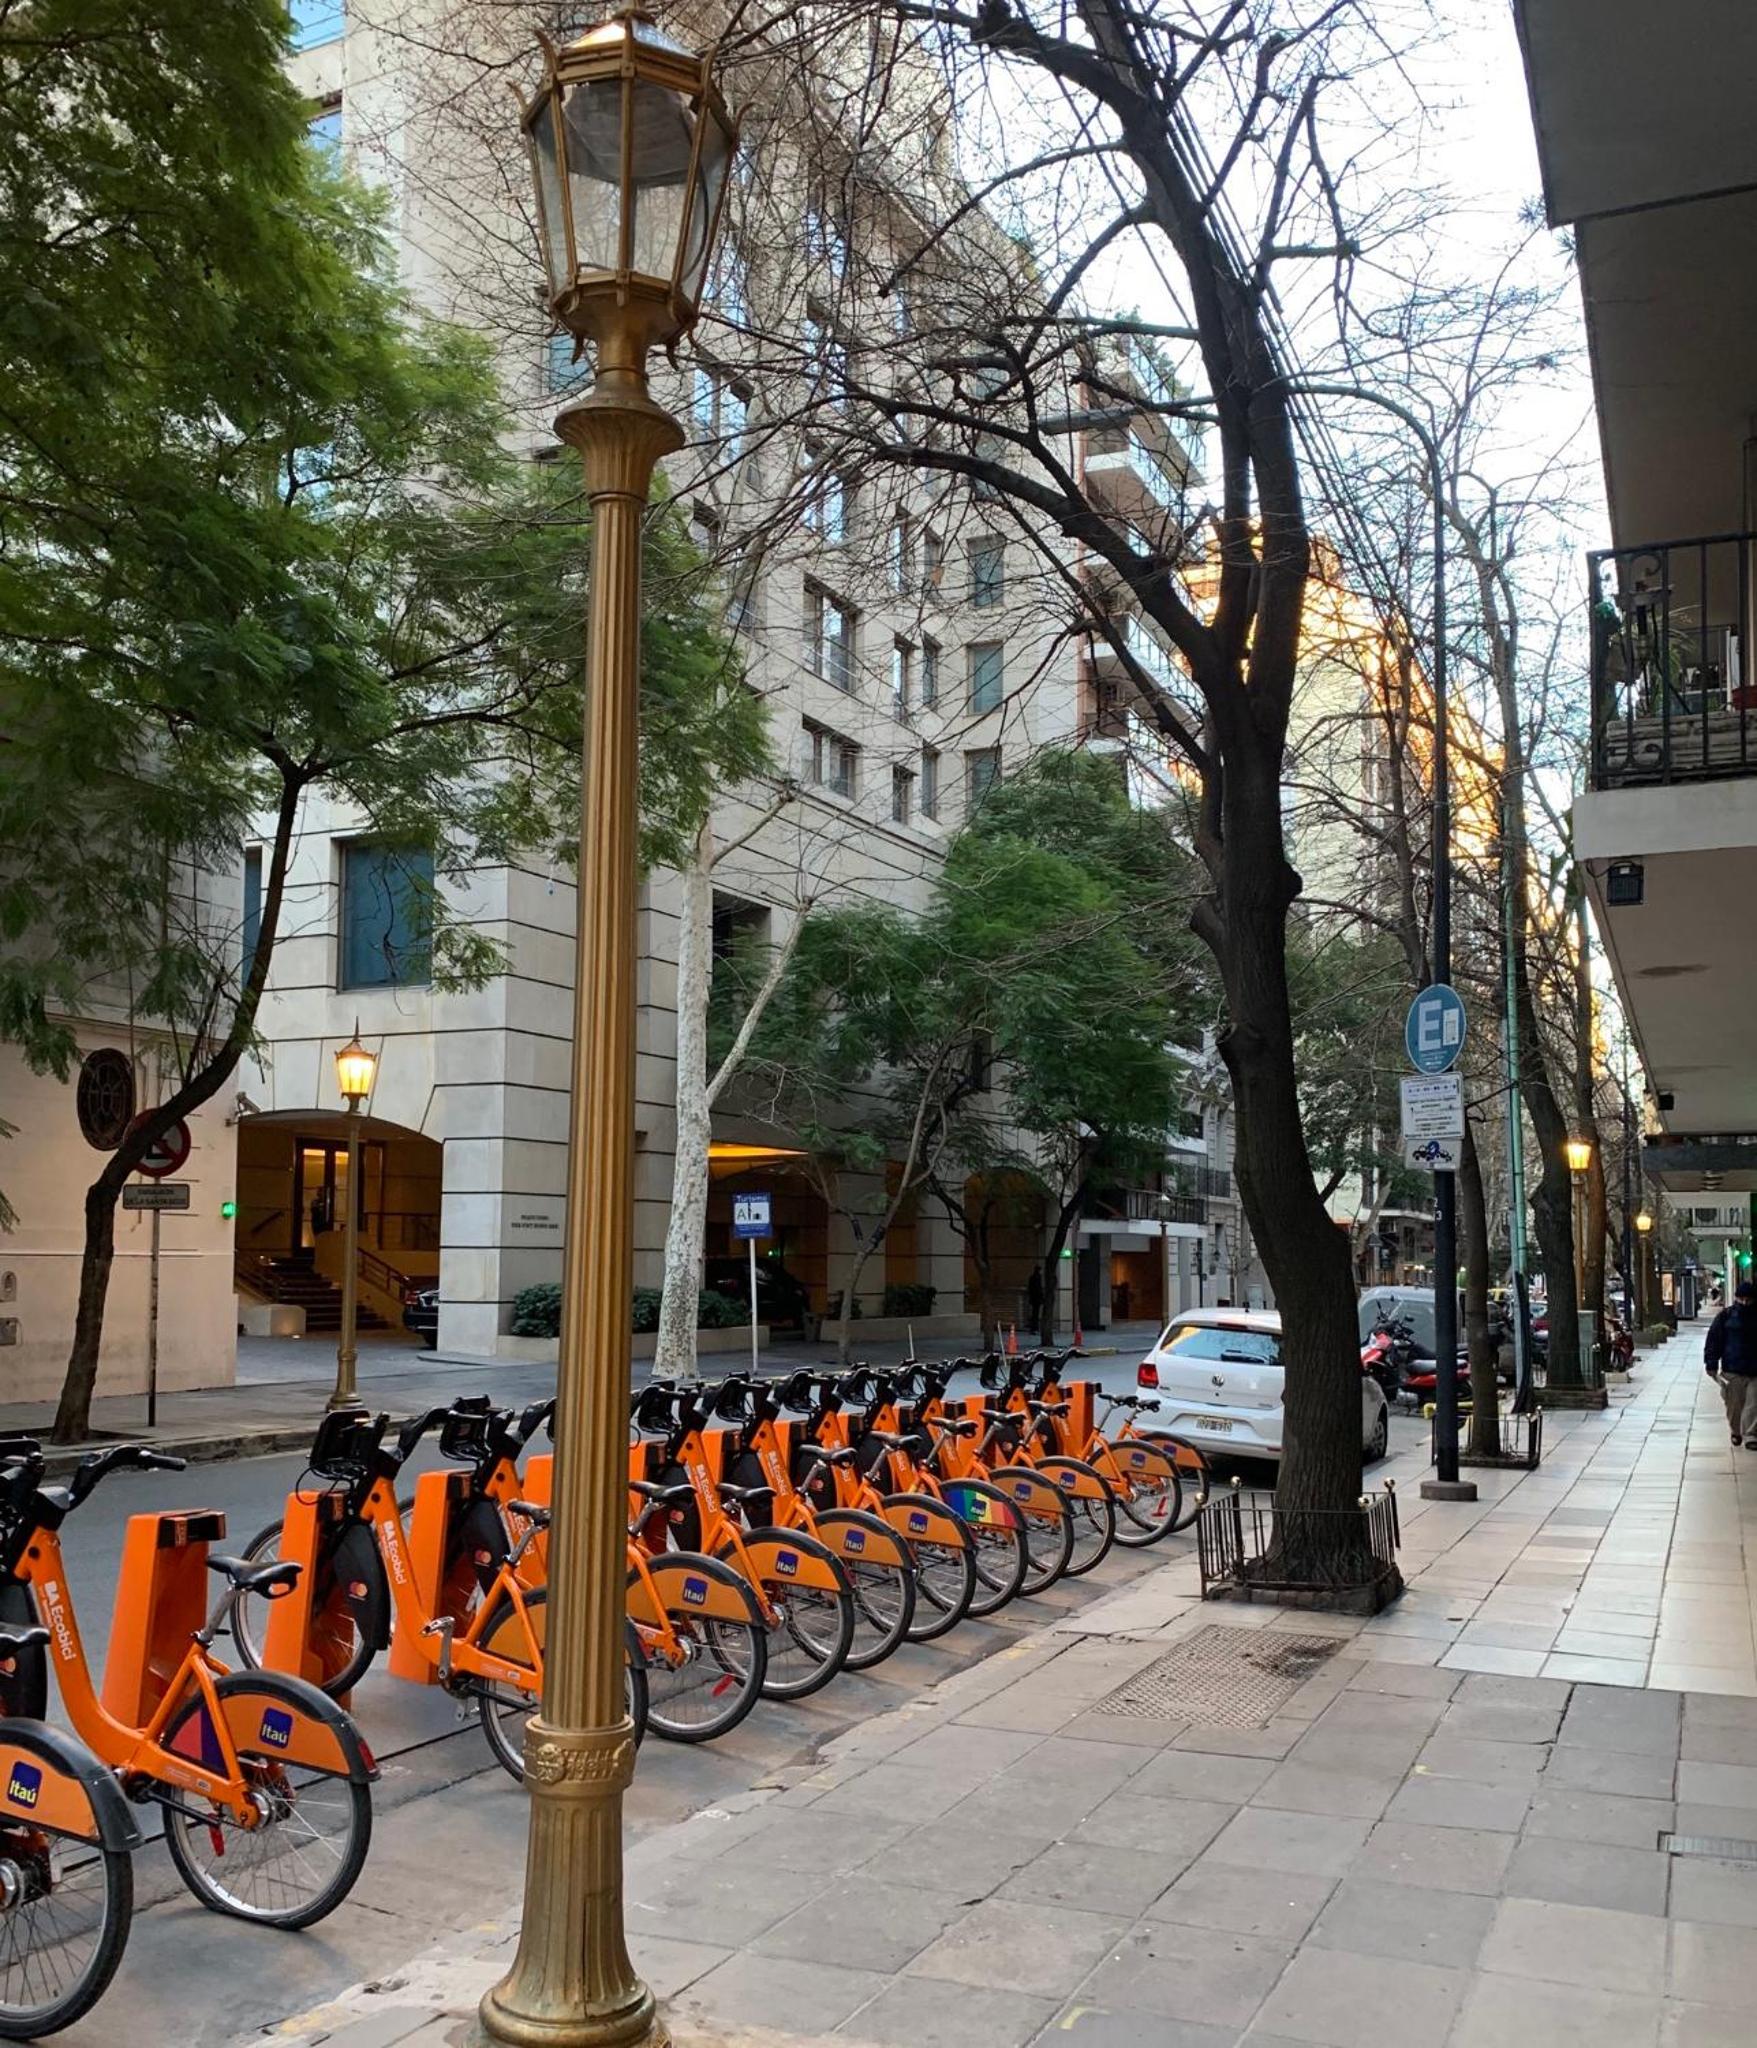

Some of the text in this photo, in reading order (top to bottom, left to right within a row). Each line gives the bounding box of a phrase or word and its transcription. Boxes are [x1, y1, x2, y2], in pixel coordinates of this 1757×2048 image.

[1418, 1000, 1442, 1052] E
[383, 1519, 396, 1541] BA
[388, 1540, 407, 1585] Ecobici
[44, 1580, 60, 1607] BA
[50, 1606, 77, 1661] Ecobici
[261, 1723, 288, 1744] Itaú
[10, 1780, 37, 1803] Itaú
